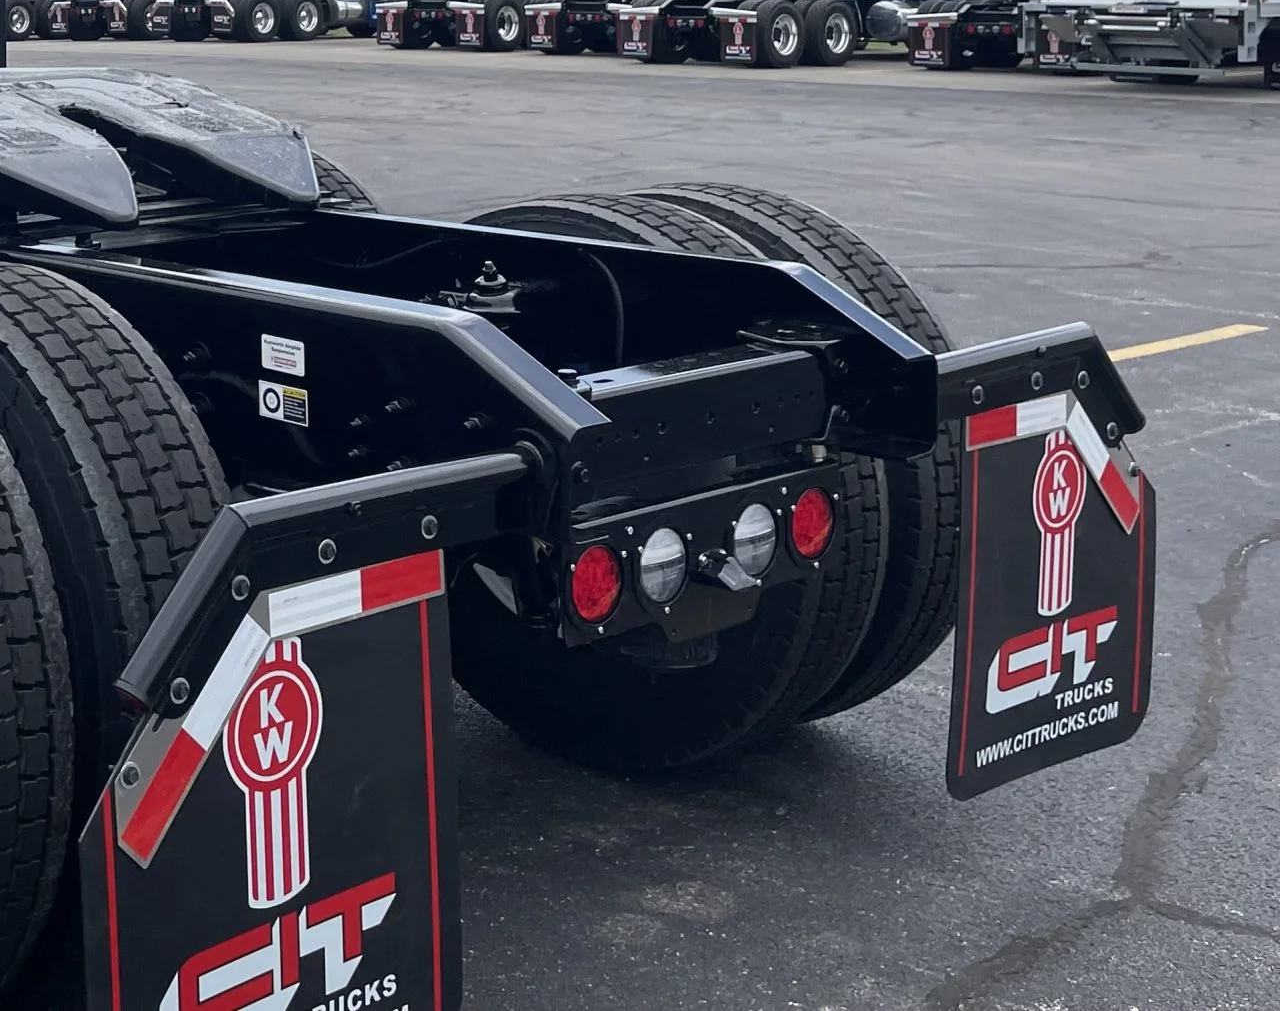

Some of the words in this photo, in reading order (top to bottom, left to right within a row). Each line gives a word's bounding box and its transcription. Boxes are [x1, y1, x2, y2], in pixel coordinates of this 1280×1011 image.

[1053, 460, 1068, 490] K
[1049, 487, 1071, 520] W
[986, 605, 1118, 714] CIT
[259, 682, 285, 729] K
[1055, 678, 1113, 710] TRUCKS
[253, 721, 293, 771] W
[976, 701, 1119, 768] WWW.CITTRUCKS.COM
[158, 872, 396, 1011] CIT
